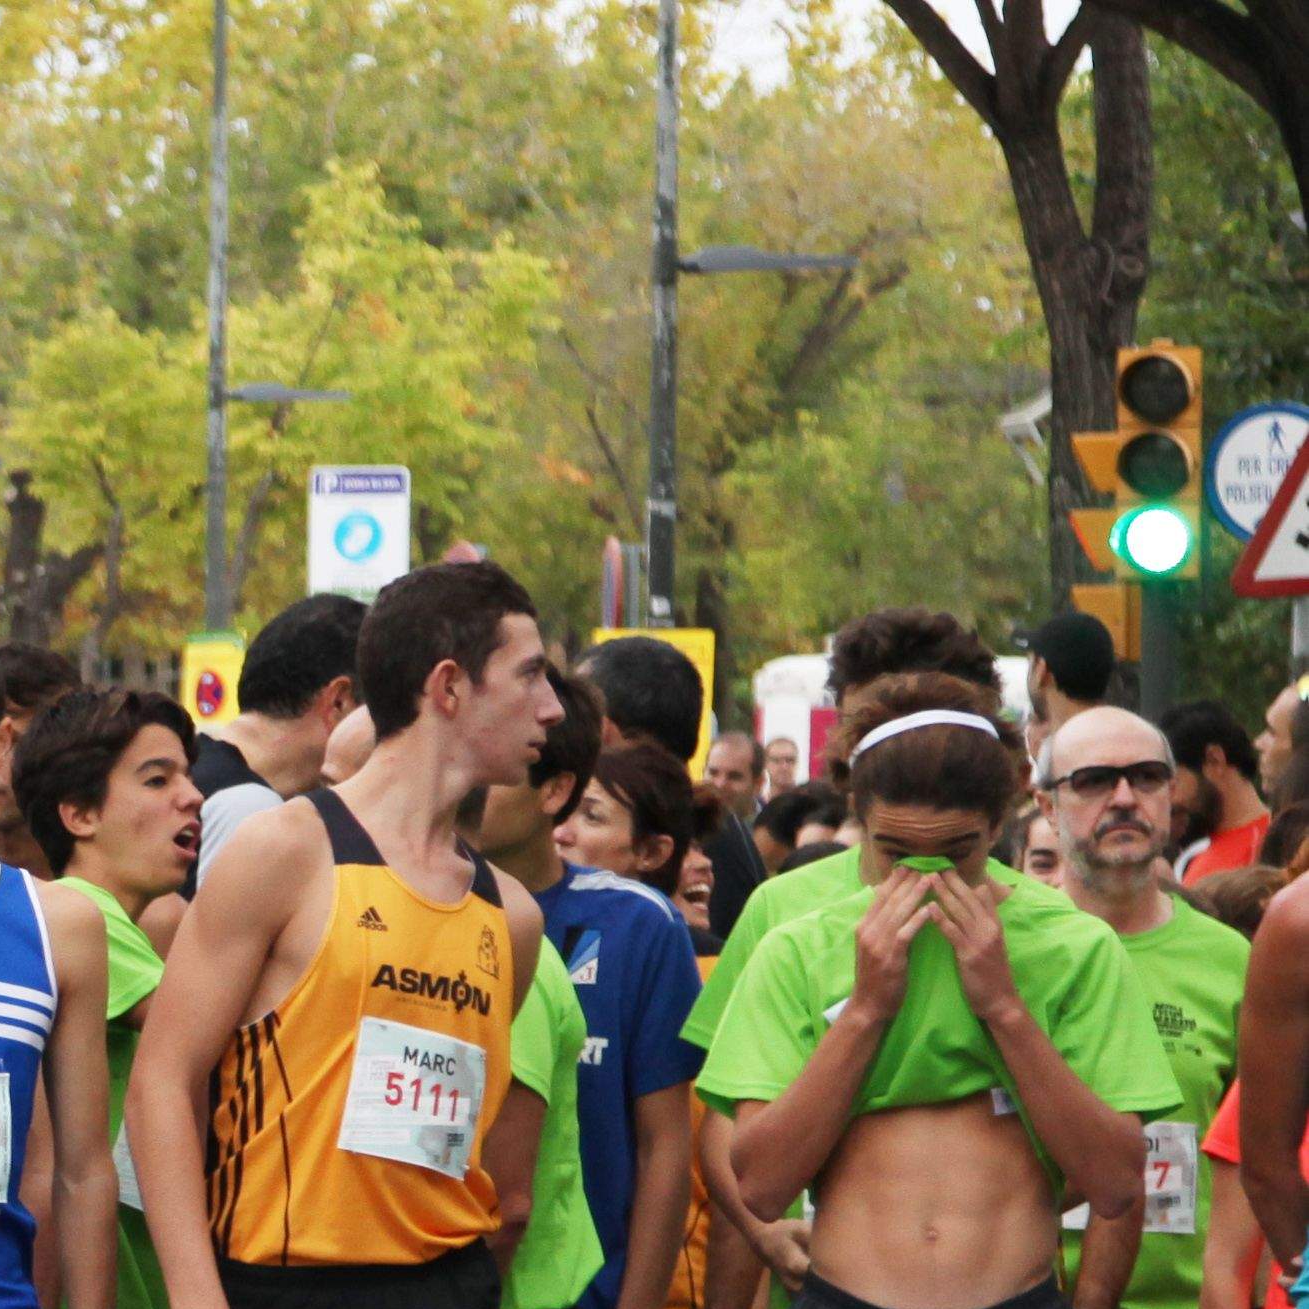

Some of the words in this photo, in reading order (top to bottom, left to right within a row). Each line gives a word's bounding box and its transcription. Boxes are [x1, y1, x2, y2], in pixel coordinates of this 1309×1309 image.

[403, 1046, 457, 1076] MARC
[384, 1072, 460, 1121] 5111
[1153, 1161, 1171, 1190] 7
